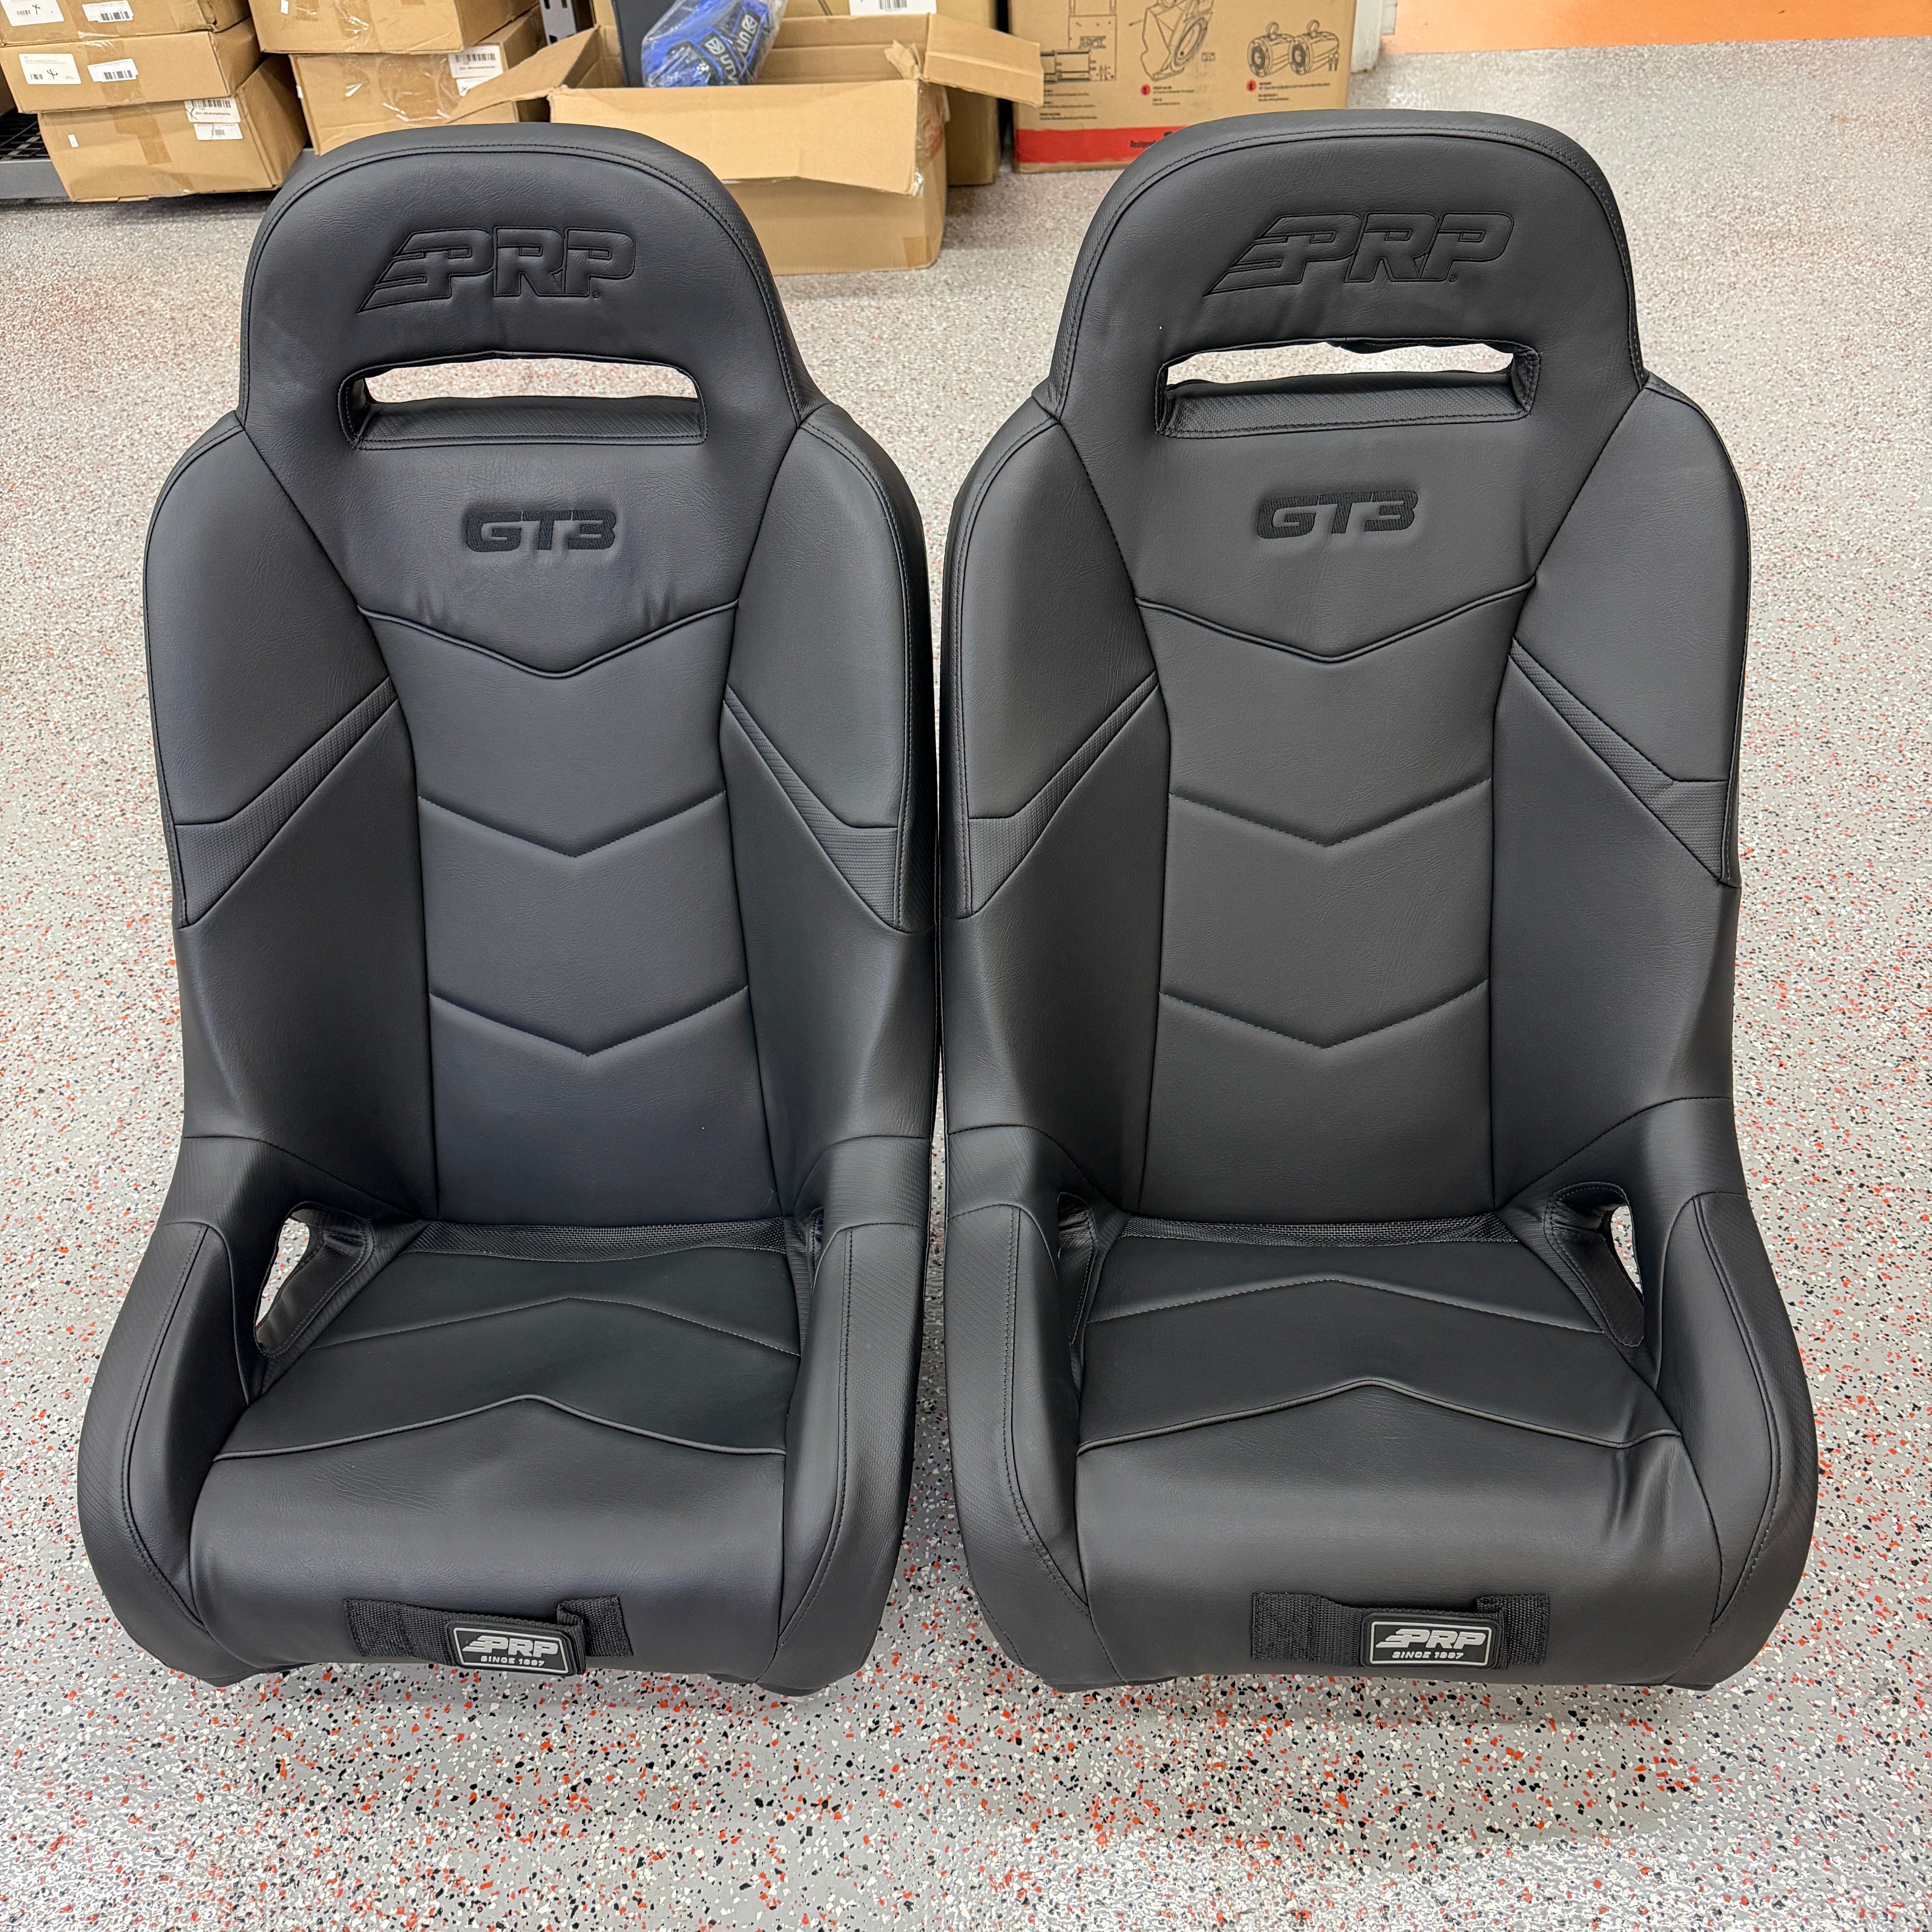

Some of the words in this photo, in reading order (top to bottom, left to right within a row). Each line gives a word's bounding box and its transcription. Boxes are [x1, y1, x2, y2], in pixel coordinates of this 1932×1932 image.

[357, 226, 636, 313] PRP
[1202, 212, 1514, 296] PRP
[1257, 490, 1418, 539] GT3
[466, 510, 616, 552] GT3
[462, 1635, 558, 1657] PRP
[1375, 1628, 1486, 1649] PRP
[481, 1656, 515, 1664] SINCE
[1392, 1651, 1431, 1659] SINCE
